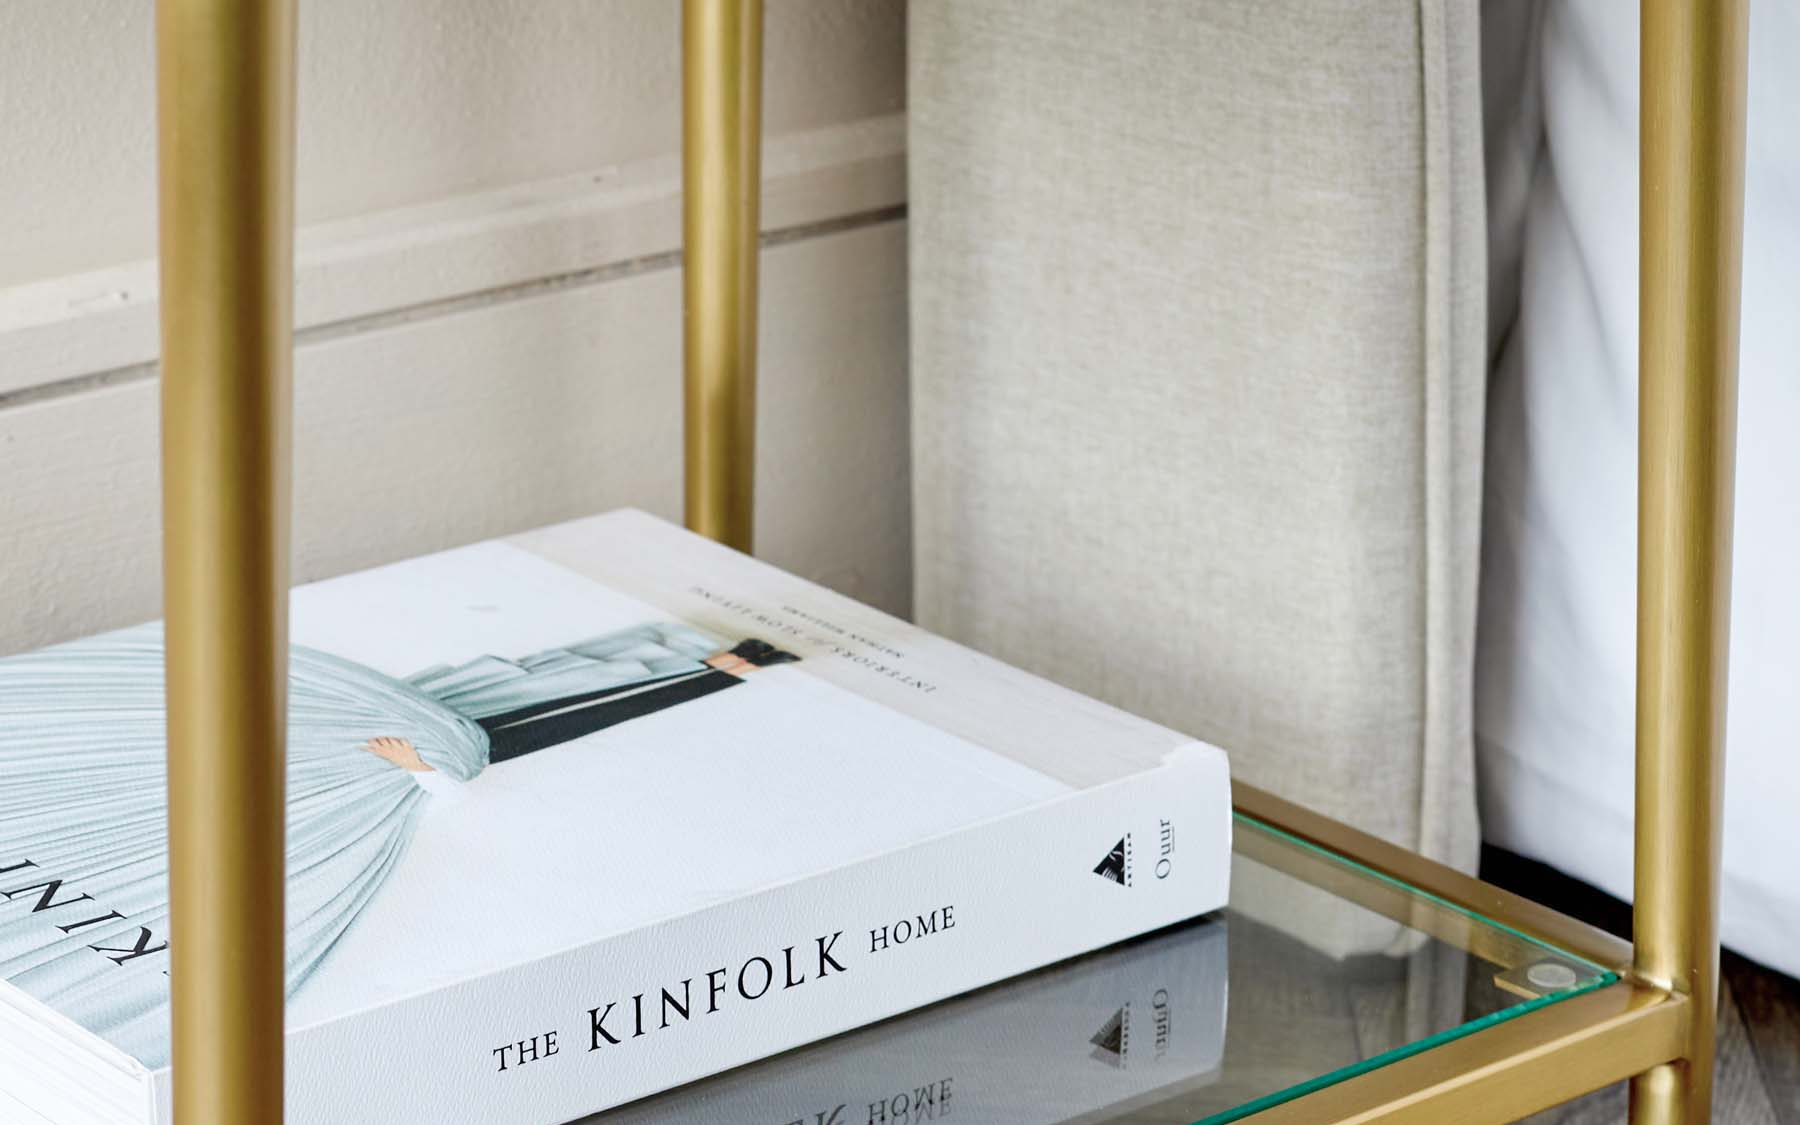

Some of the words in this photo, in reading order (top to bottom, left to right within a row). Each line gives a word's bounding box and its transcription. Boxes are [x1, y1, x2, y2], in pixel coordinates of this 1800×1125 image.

[831, 645, 937, 693] INTERIORS
[1155, 819, 1174, 880] Ouur
[0, 858, 170, 967] KIN
[492, 1031, 560, 1072] THE
[587, 930, 848, 1052] KINFOLK
[869, 905, 957, 953] HOME
